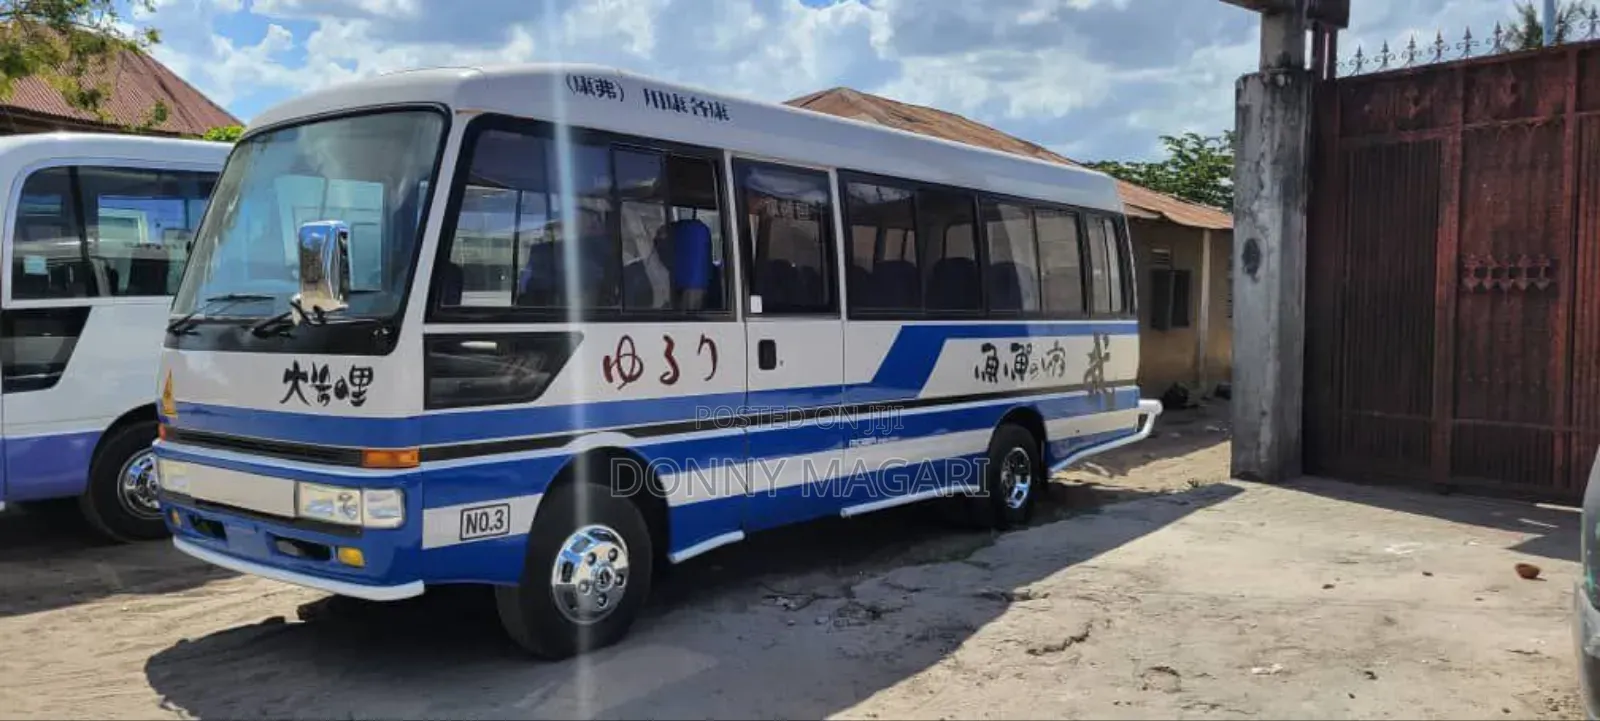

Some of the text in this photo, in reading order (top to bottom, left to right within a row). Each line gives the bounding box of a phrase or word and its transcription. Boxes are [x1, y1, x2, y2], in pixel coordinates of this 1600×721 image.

[603, 334, 718, 390] ゆるり
[466, 509, 505, 535] NO.3
